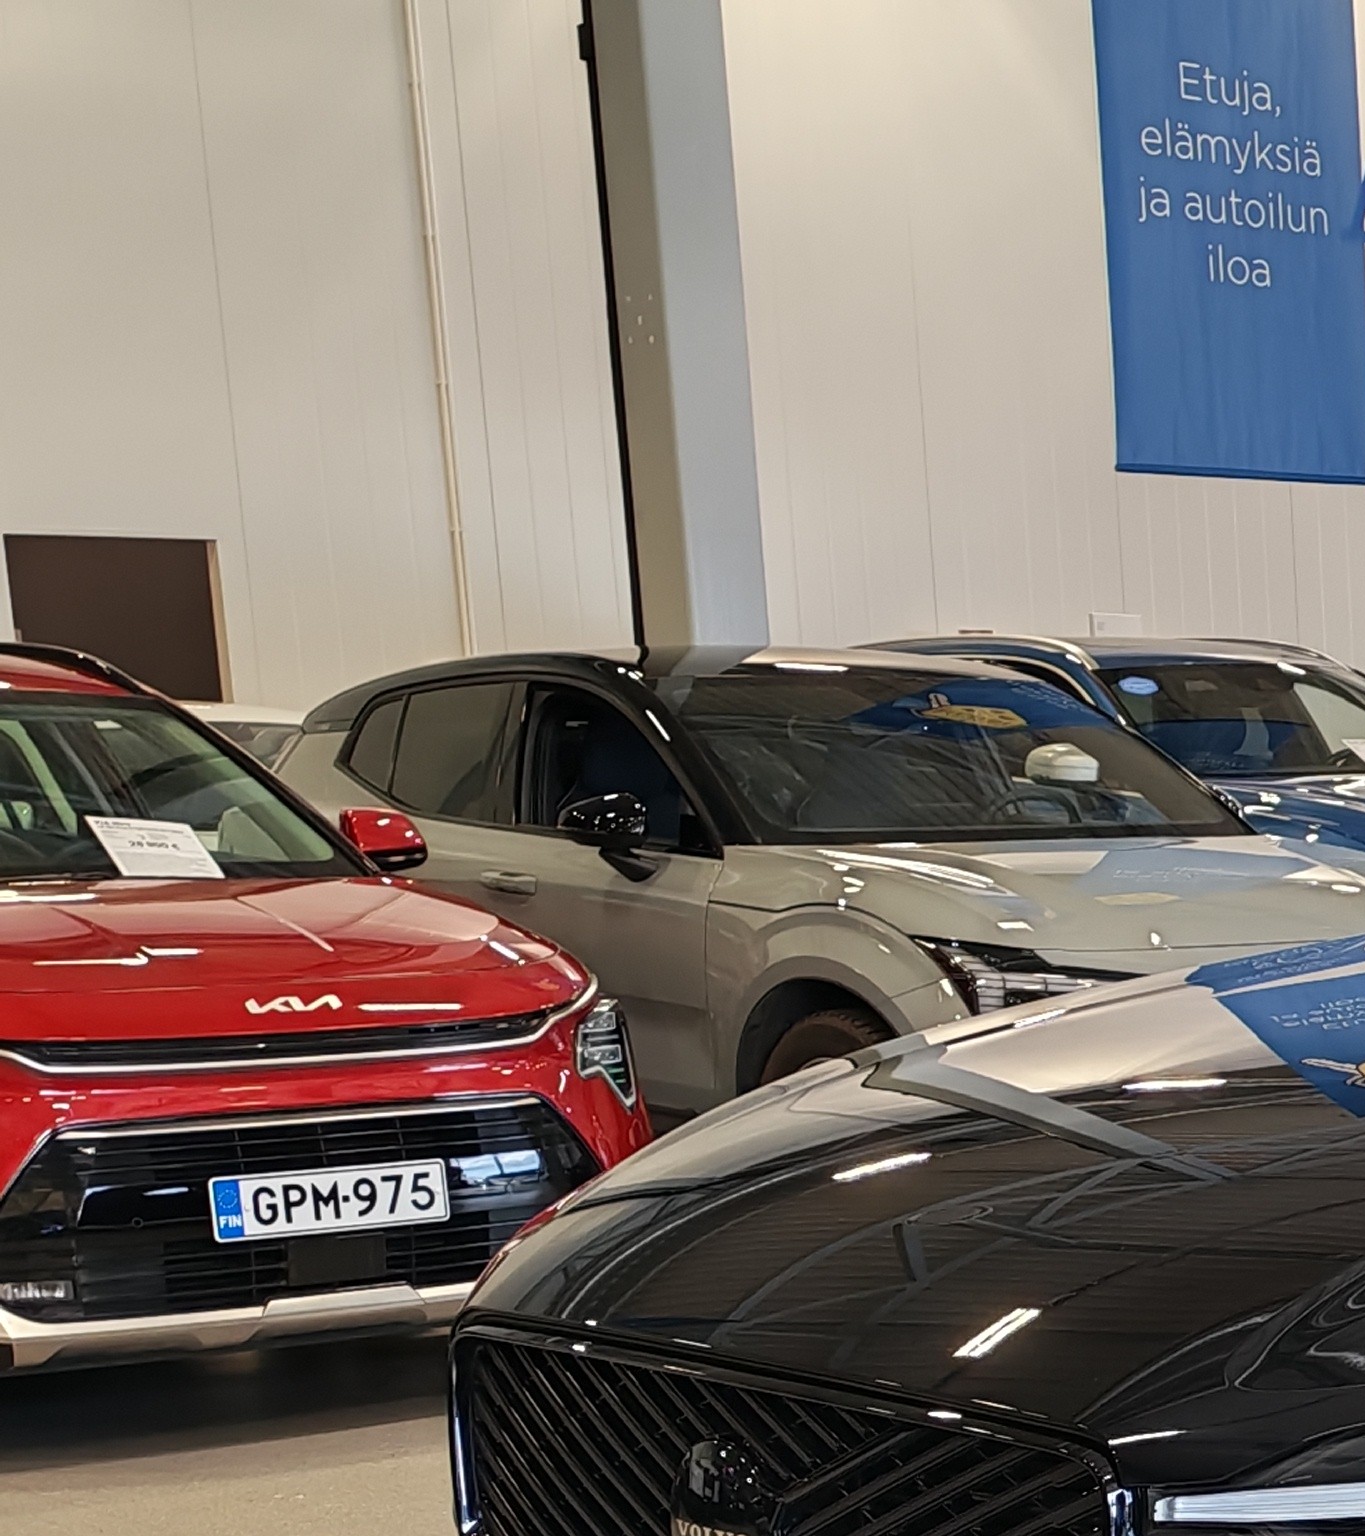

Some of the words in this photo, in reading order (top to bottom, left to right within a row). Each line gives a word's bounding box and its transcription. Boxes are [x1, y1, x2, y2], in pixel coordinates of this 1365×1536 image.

[1178, 61, 1281, 118] Etuja,
[1140, 117, 1322, 177] elämyksiä
[1138, 176, 1171, 223] ja
[1184, 188, 1329, 236] autoilun
[1208, 244, 1271, 287] iloa
[245, 994, 343, 1014] KIA
[219, 1214, 243, 1228] FIN
[252, 1172, 436, 1226] GPM-975
